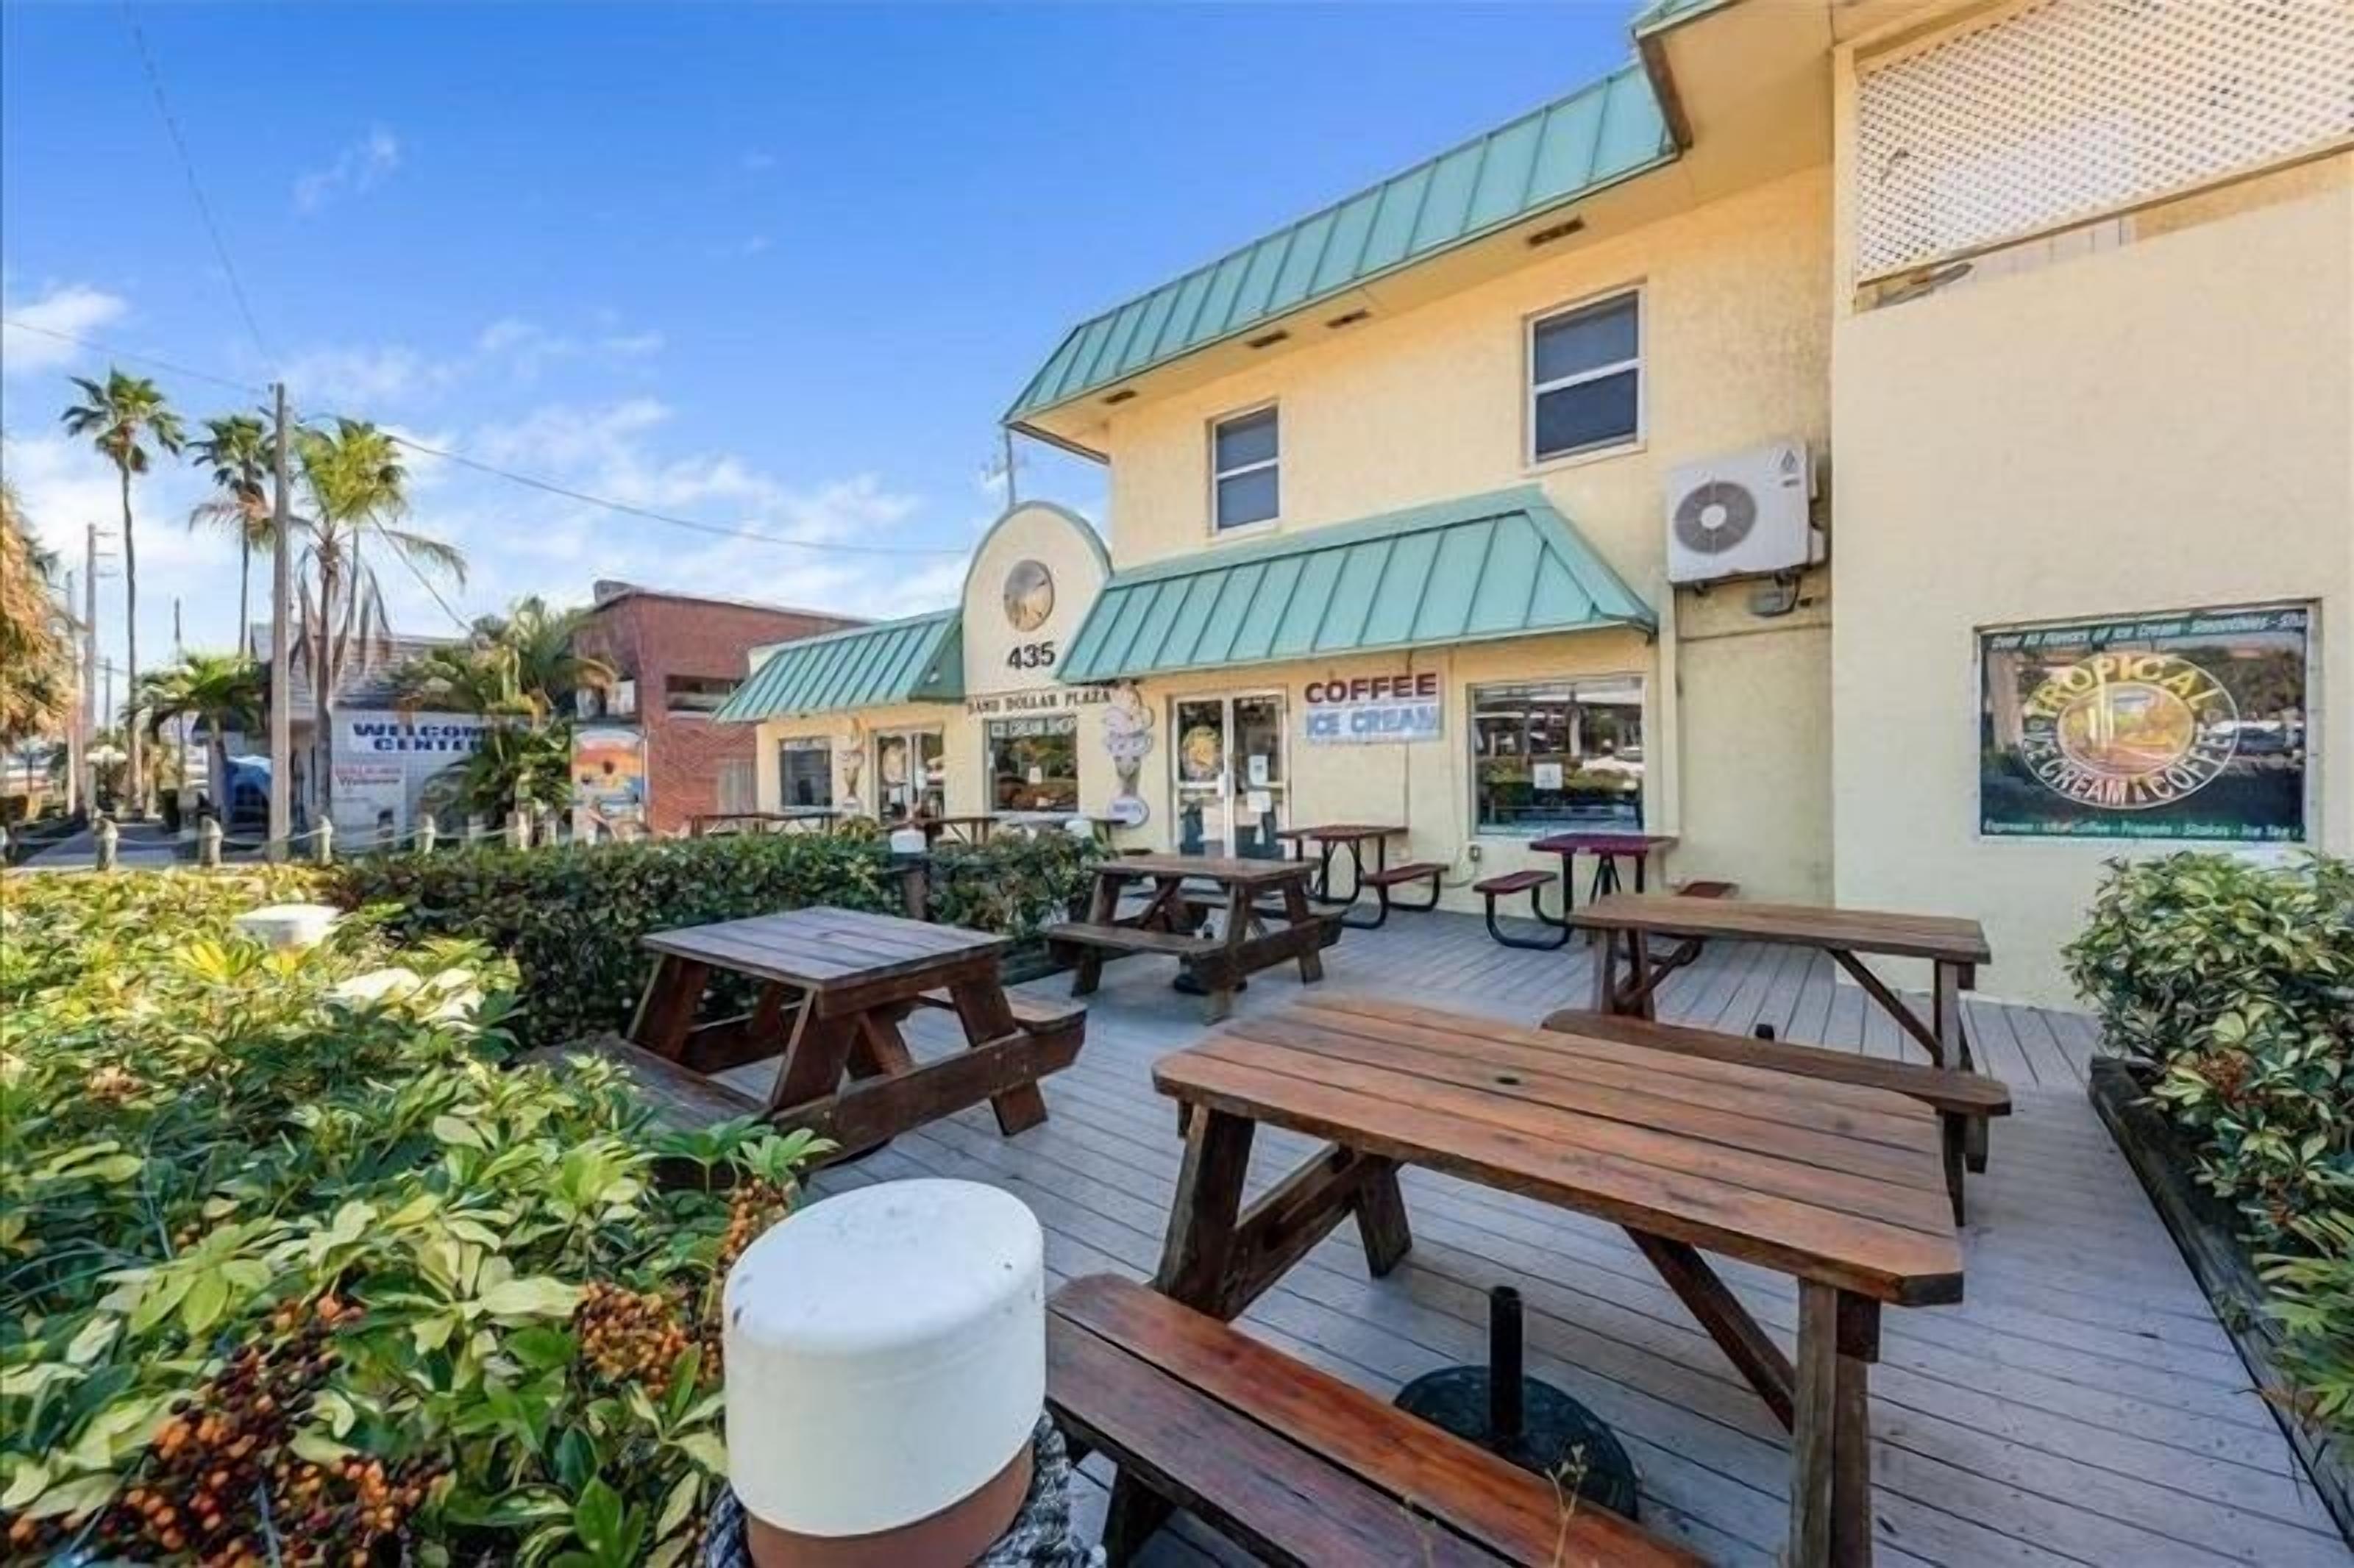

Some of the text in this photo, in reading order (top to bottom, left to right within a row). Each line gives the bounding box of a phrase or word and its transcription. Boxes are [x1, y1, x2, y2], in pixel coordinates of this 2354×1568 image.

[1007, 641, 1056, 670] 435
[1005, 694, 1058, 712] DOLLAR
[1065, 688, 1112, 707] PLAZA
[1304, 673, 1437, 704] COFFEE
[2024, 653, 2221, 718] TROPICAL
[1306, 706, 1437, 736] ICE CREAM
[2038, 758, 2129, 803] CREAM
